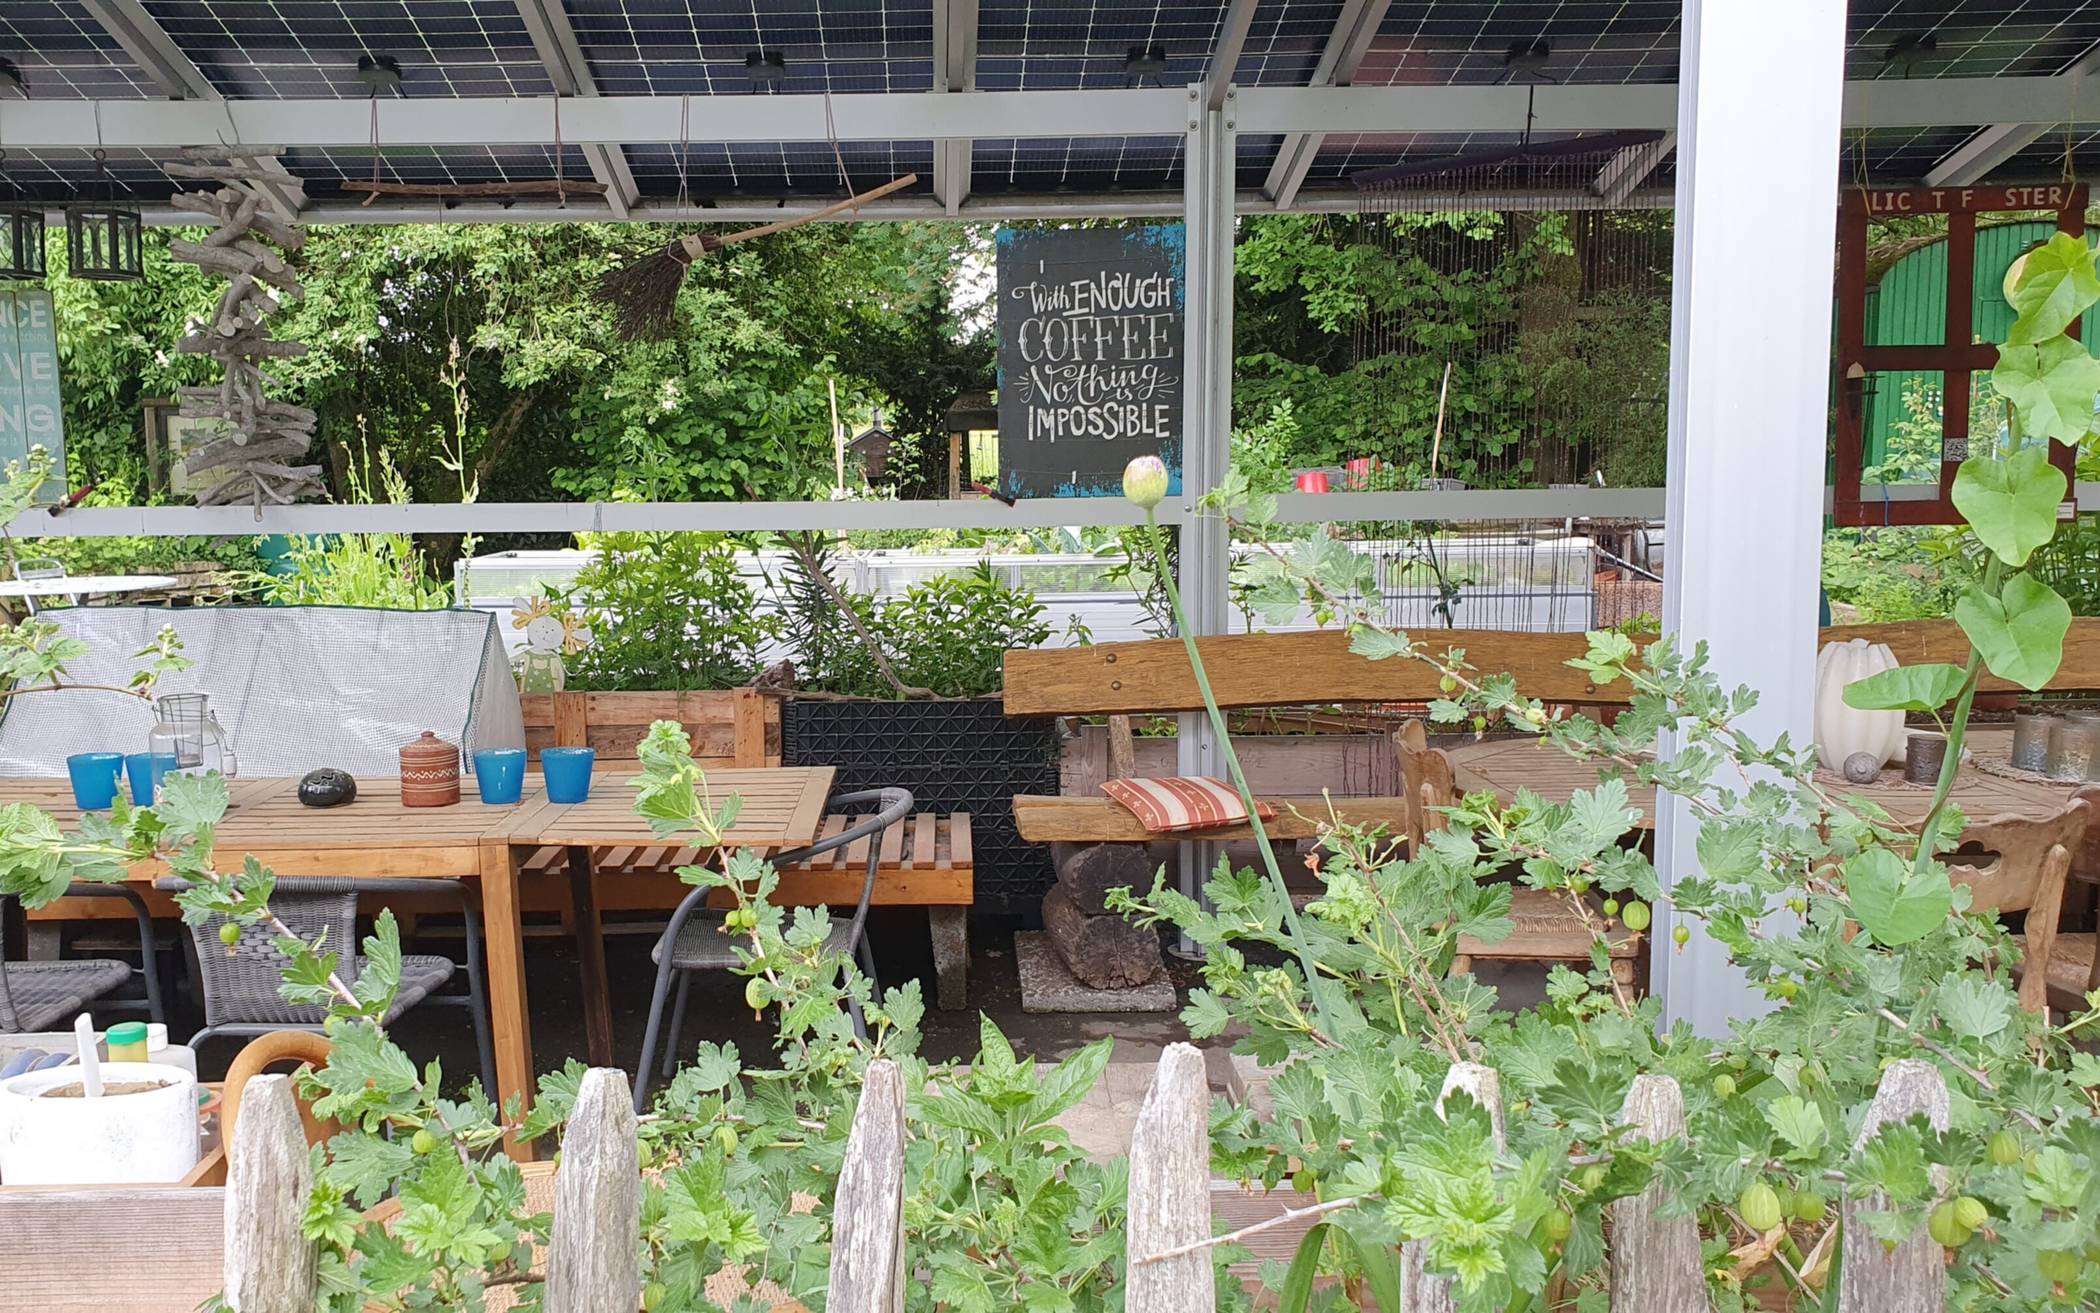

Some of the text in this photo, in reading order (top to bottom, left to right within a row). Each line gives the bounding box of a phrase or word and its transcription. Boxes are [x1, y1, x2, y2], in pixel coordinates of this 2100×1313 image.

[1012, 270, 1174, 316] With ENOUGH
[1018, 313, 1174, 362] COFFEE
[1020, 364, 1178, 405] Nothing is
[1028, 401, 1170, 443] IMPOSSIBLE
